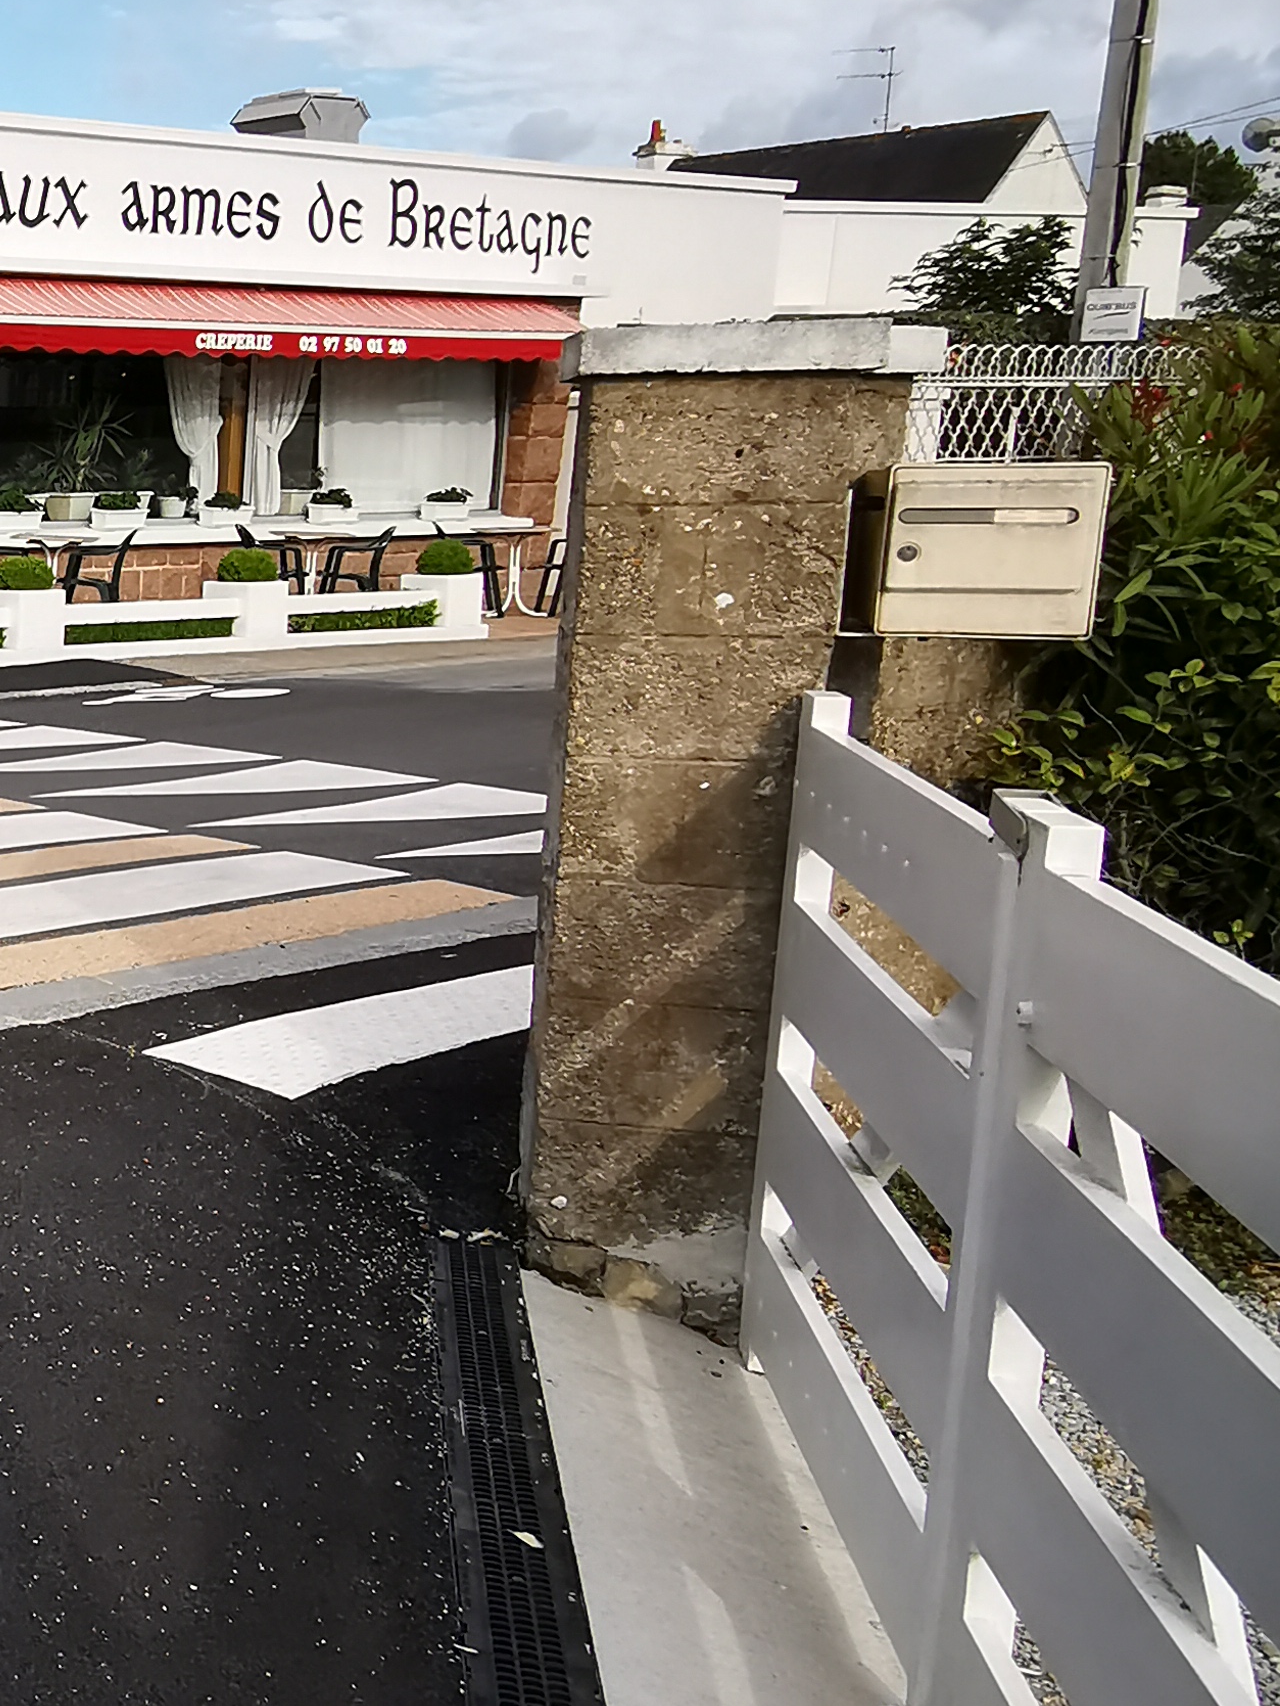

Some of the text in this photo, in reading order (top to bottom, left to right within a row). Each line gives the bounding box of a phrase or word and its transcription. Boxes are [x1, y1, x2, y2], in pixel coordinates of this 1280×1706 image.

[121, 180, 281, 241] armes
[307, 181, 363, 244] de
[388, 178, 592, 274] Bretagne
[195, 332, 407, 355] CREPERIE 02 97 50 01 20
